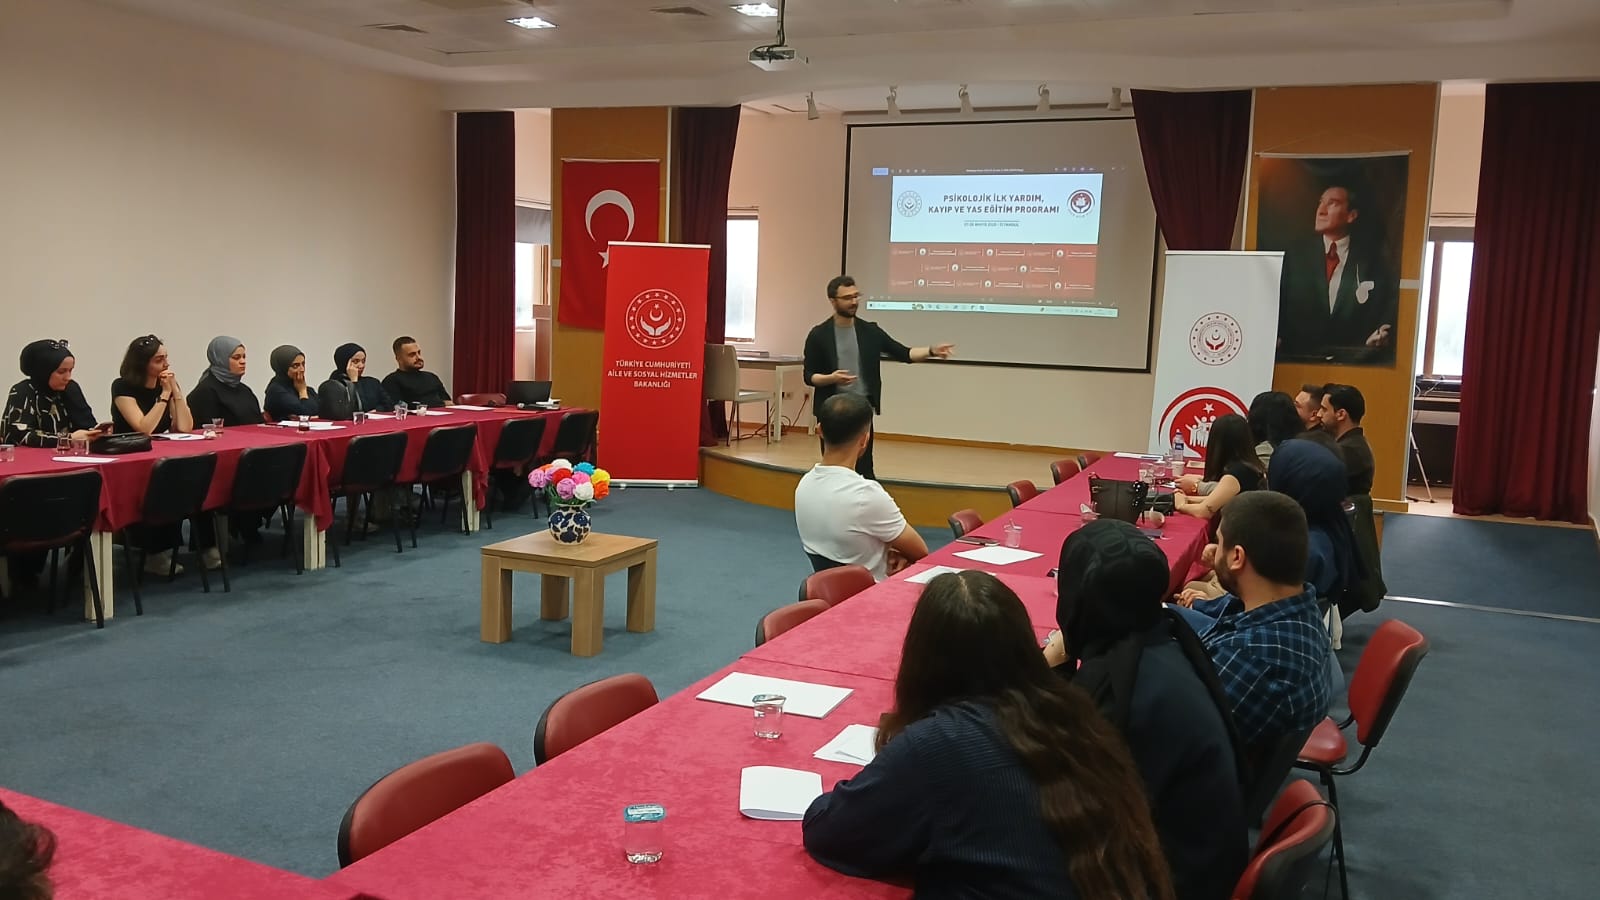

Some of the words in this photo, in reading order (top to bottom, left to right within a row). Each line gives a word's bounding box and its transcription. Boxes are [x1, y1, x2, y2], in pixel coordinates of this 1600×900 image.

[943, 193, 991, 202] PSİKOLOJİK
[993, 193, 1007, 202] İLK
[1009, 194, 1044, 203] YARDIM,
[928, 206, 953, 214] KAYIP
[954, 206, 965, 214] VE
[984, 204, 1013, 214] EĞİTİM
[1014, 205, 1060, 214] PROGRAMI
[616, 359, 644, 368] TÜRKİYE
[644, 360, 691, 369] CUMHURİYETİ
[607, 369, 622, 377] AİLE
[633, 370, 659, 378] SOSYAL
[660, 370, 698, 379] HİZMETLER
[633, 380, 671, 388] BAKANLIĞI
